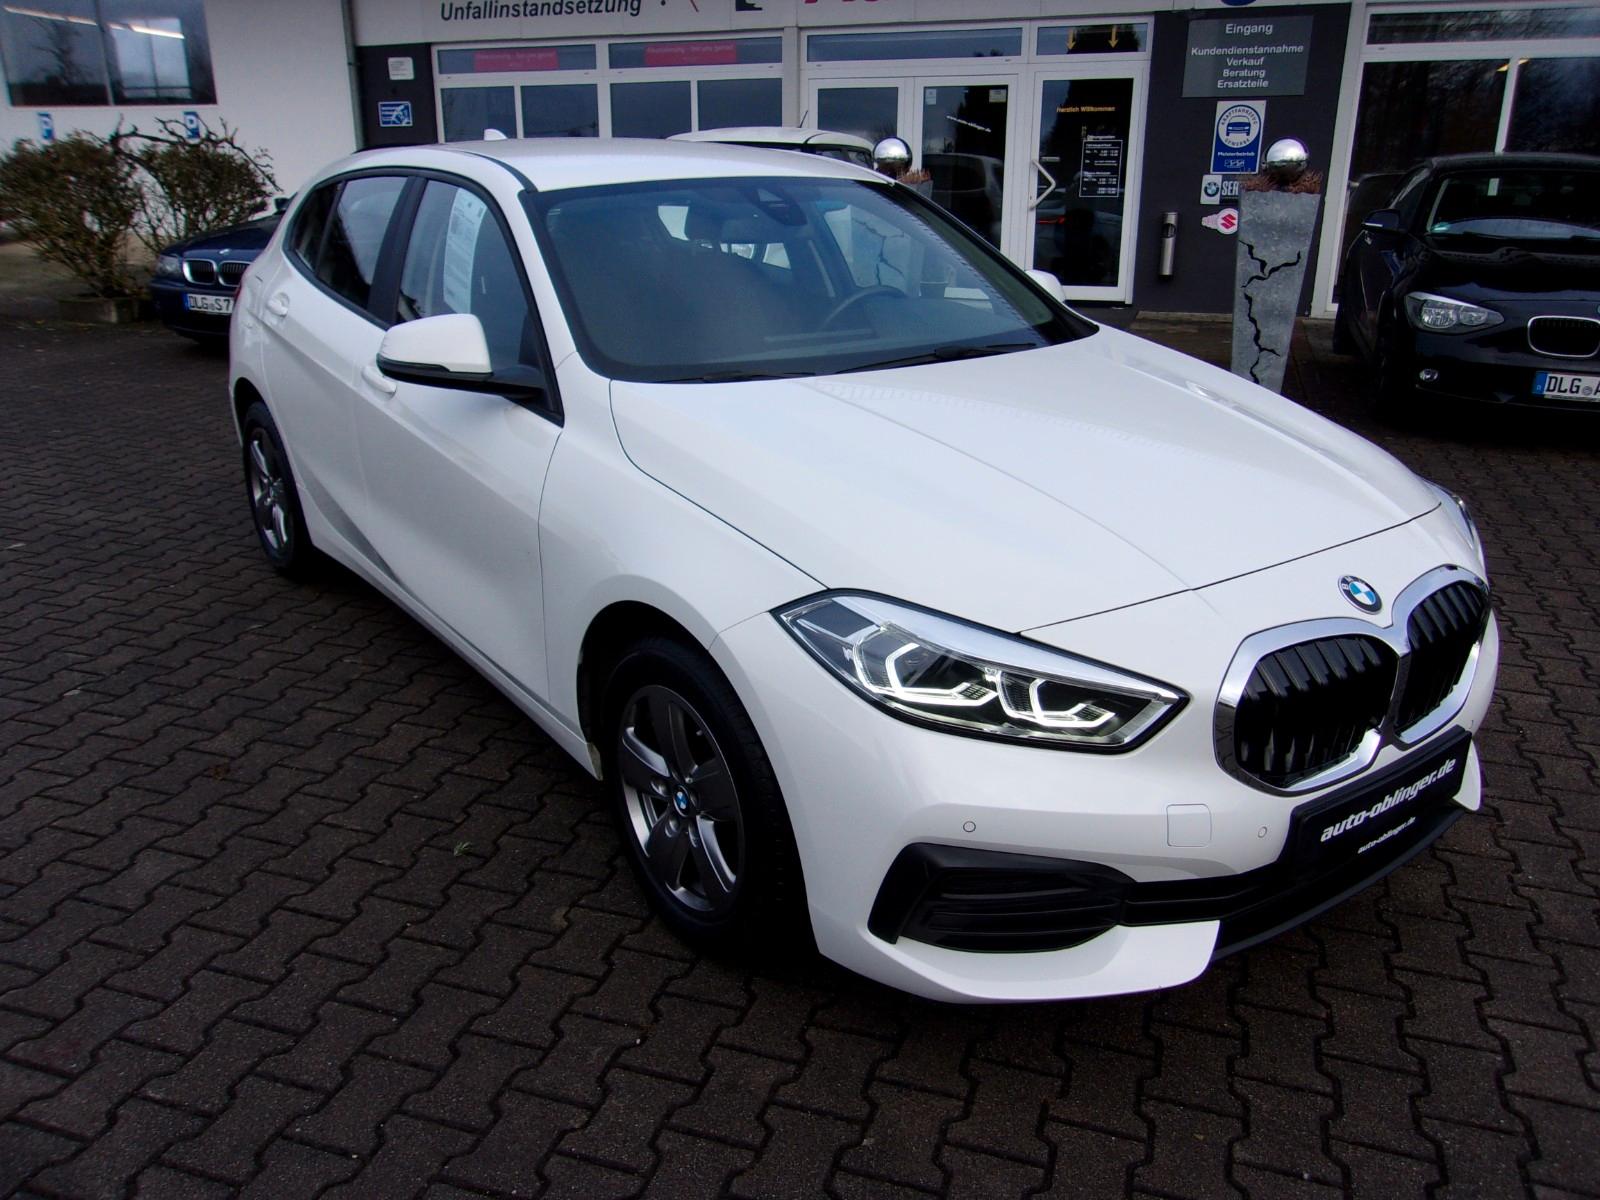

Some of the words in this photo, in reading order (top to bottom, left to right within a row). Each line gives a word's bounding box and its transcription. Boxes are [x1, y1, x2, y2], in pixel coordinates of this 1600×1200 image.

[441, 0, 641, 21] Unfallinstandsetzung
[1225, 24, 1274, 36] Eingang
[1191, 44, 1304, 56] Kundendienstannahme
[1226, 57, 1265, 66] Verkauf
[1222, 68, 1266, 78] Beratung
[1217, 79, 1269, 88] Ersatzteile
[1545, 375, 1582, 394] DLG
[1320, 759, 1457, 842] auto-oblinger.de
